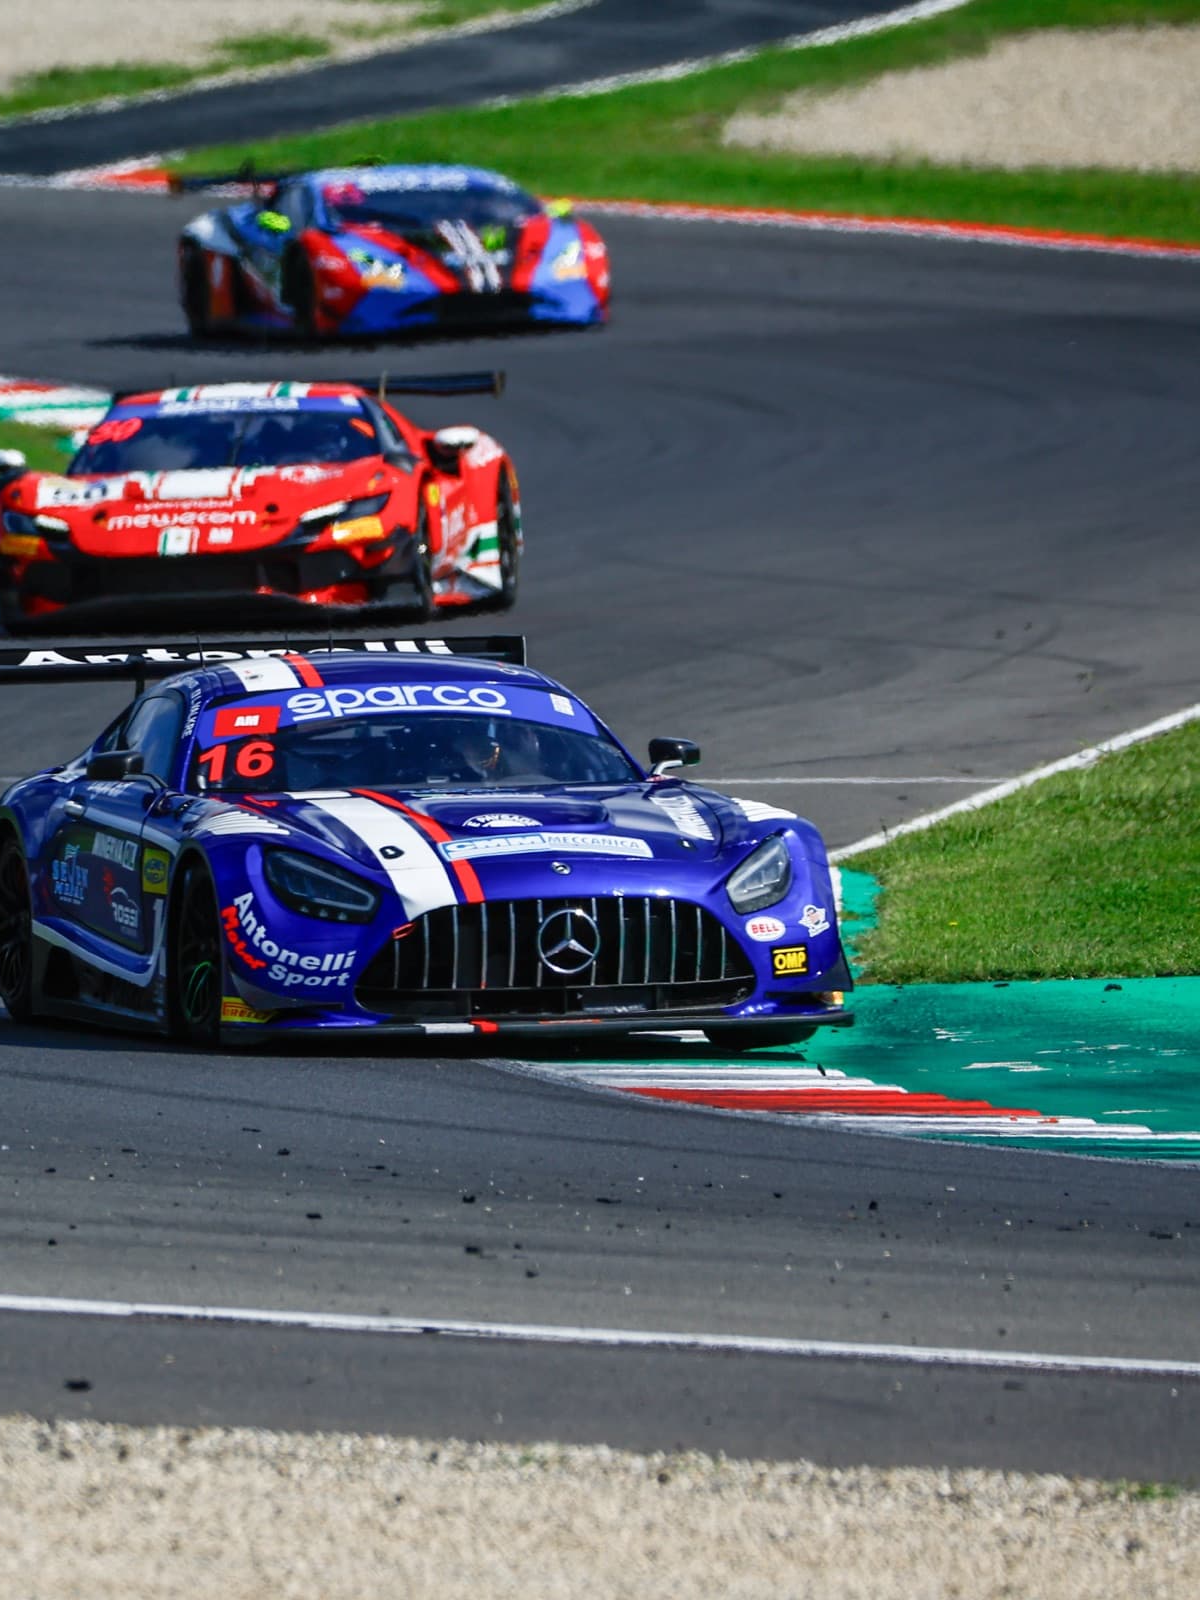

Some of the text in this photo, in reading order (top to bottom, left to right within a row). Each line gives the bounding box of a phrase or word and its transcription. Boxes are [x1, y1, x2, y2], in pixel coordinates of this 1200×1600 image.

[287, 684, 509, 719] sparco
[234, 714, 260, 728] AM
[198, 740, 276, 782] 16
[548, 836, 640, 849] MECCANICA
[233, 891, 357, 972] Antonelli
[751, 922, 780, 935] BELL
[773, 951, 807, 970] OMP
[267, 963, 350, 987] Sport
